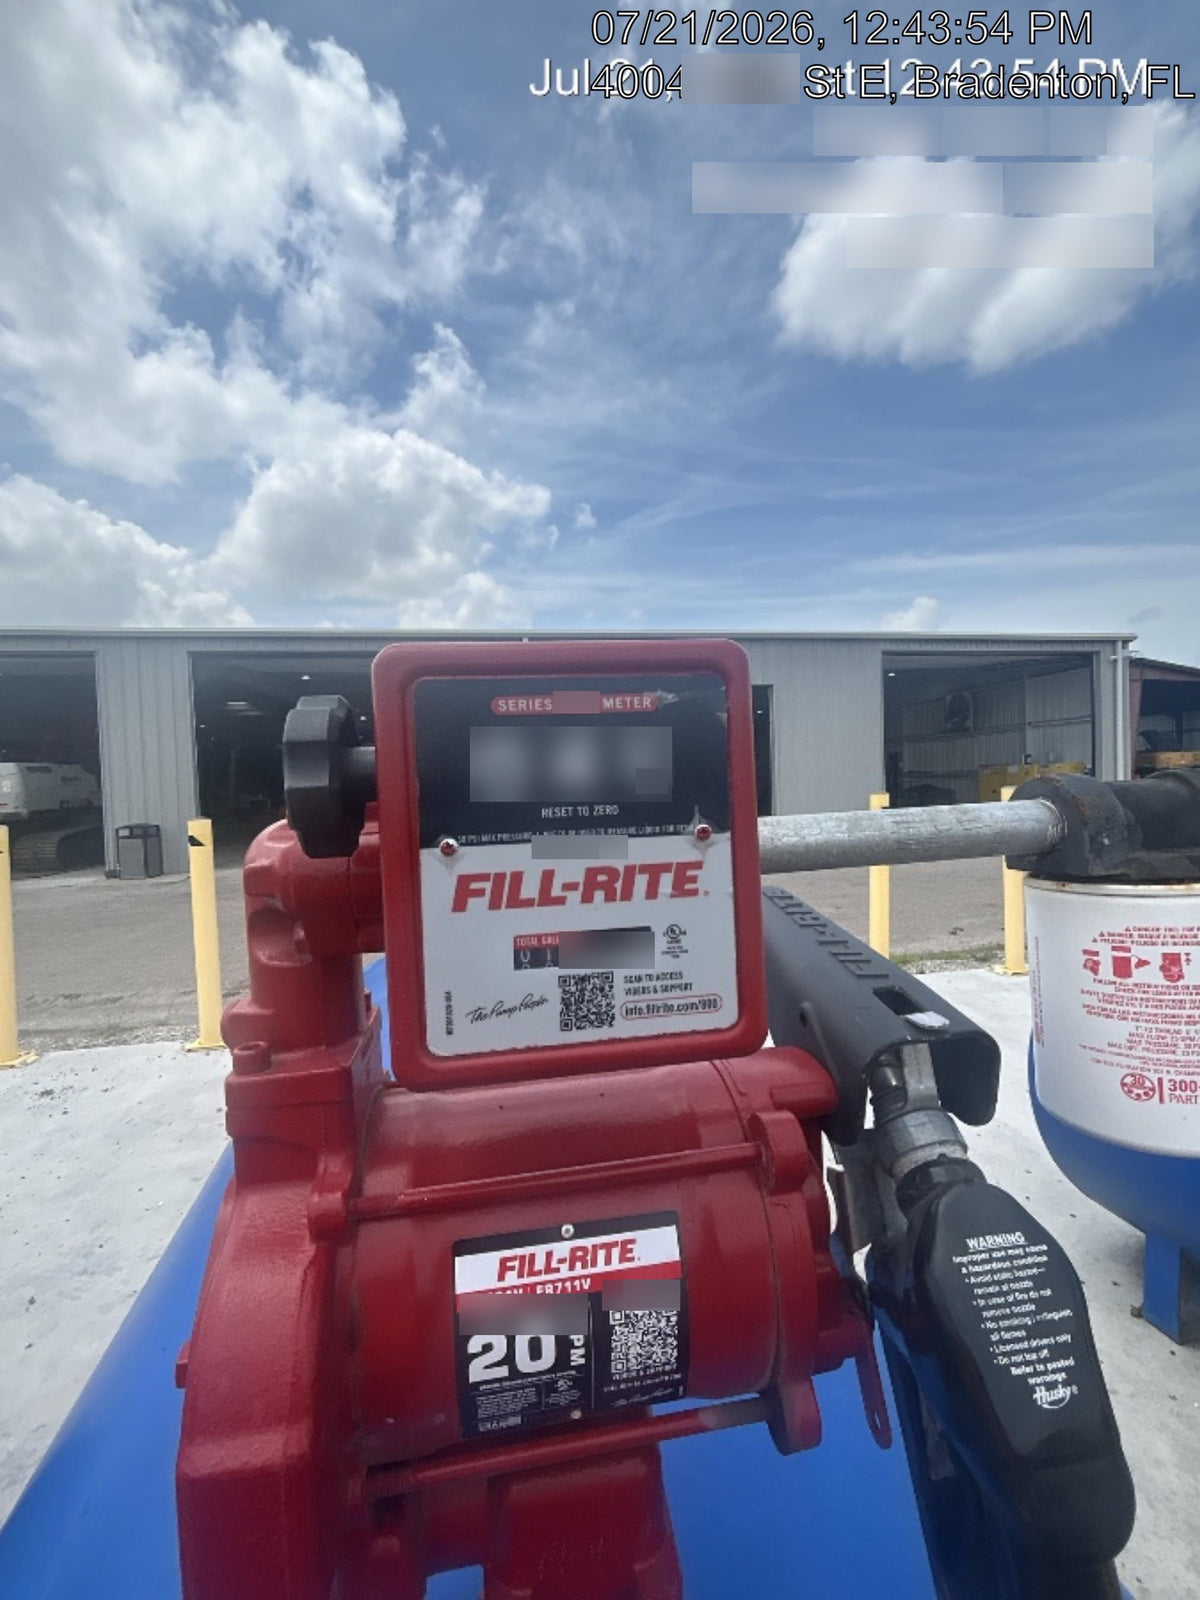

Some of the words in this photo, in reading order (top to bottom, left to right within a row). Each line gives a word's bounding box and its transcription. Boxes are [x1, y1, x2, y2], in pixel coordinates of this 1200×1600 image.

[498, 699, 553, 711] SERIES
[603, 697, 652, 709] METER
[542, 806, 573, 818] RESET
[577, 806, 590, 817] TO
[593, 804, 619, 816] ZERO
[451, 860, 704, 913] FILL-RITE
[1168, 1094, 1199, 1105] PART
[965, 1231, 1026, 1251] WARNING
[497, 1238, 637, 1282] FILL-RITE
[467, 1334, 556, 1384] 20
[569, 1335, 586, 1367] PM
